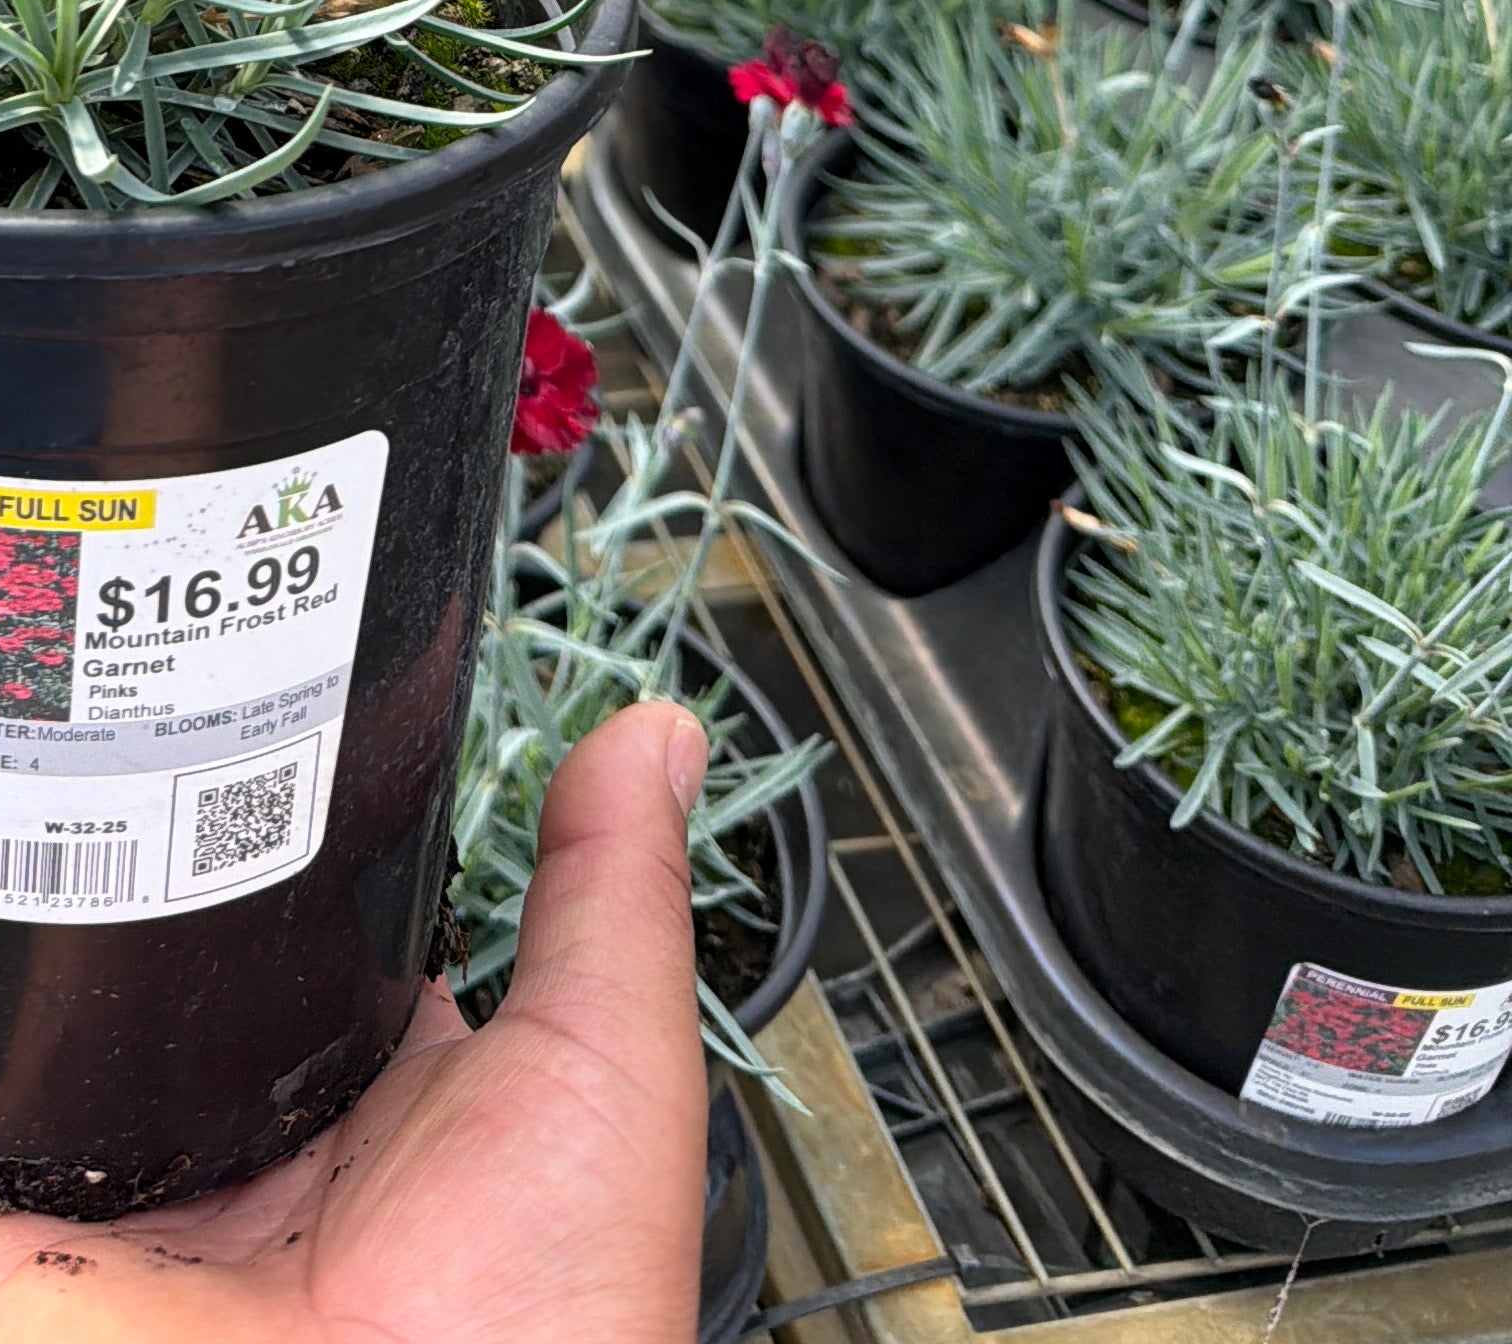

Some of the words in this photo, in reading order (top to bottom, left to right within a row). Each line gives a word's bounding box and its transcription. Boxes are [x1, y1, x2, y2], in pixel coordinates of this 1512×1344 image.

[79, 498, 138, 522] SUN
[236, 482, 344, 540] AKA
[96, 545, 320, 633] $16.99
[85, 624, 210, 650] Mountain
[219, 603, 286, 635] Frost
[293, 583, 339, 616] Red
[83, 655, 176, 678] Garnet
[89, 684, 138, 699] Pinks
[88, 702, 175, 720] Dianthus
[155, 710, 238, 738] BLOOMS:
[242, 700, 275, 721] Late
[278, 683, 324, 708] Spring
[326, 675, 339, 689] to
[38, 726, 116, 742] Moderate
[240, 719, 278, 740] Early
[282, 706, 308, 725] Fall
[29, 757, 40, 772] 4
[44, 820, 128, 834] W-32-25
[1306, 969, 1388, 1002] PERENNIAL
[1402, 995, 1437, 1008] FULL
